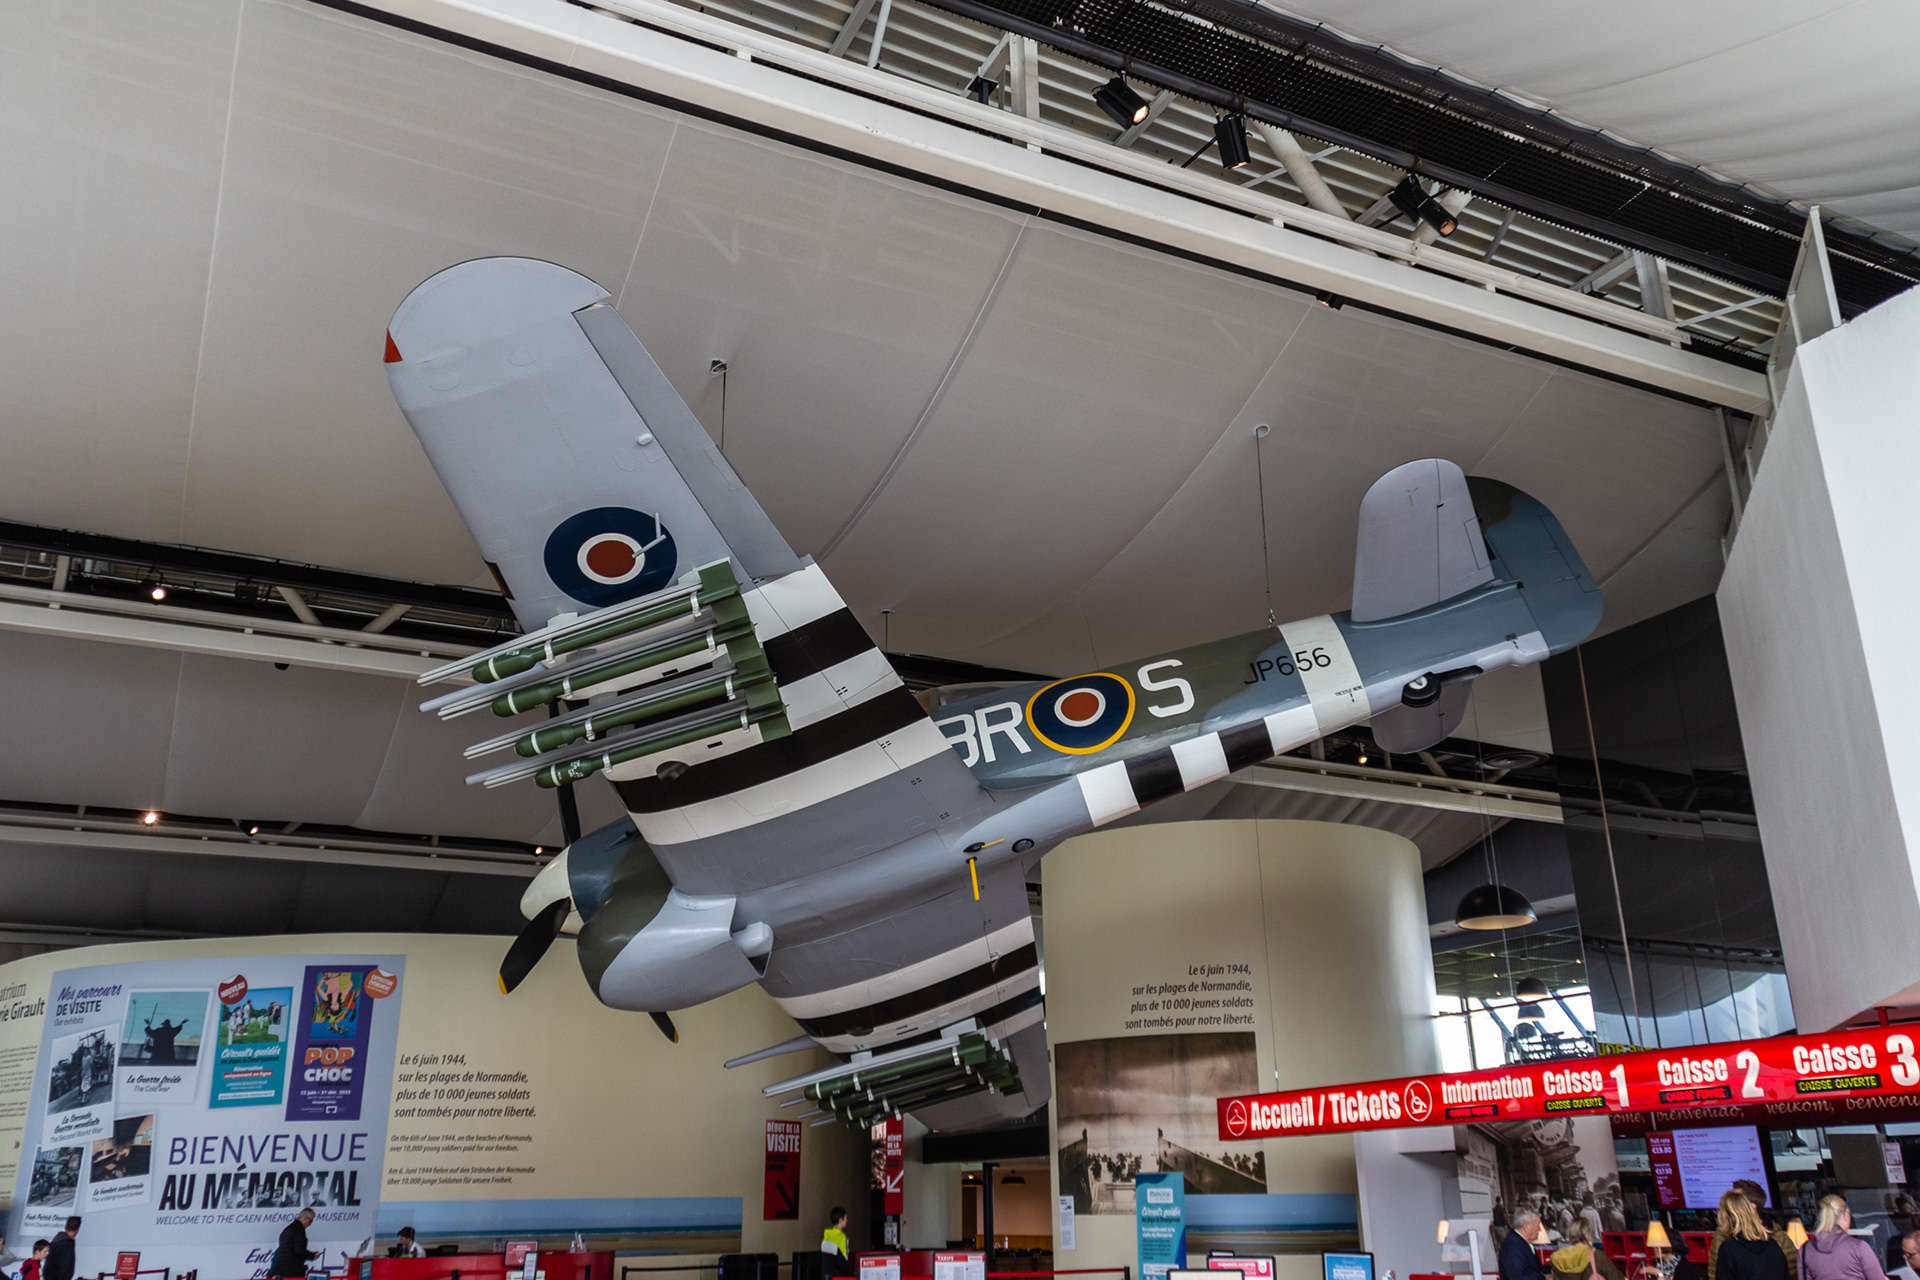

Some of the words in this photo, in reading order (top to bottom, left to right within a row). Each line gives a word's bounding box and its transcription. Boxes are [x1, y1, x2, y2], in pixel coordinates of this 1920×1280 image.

[1244, 647, 1331, 684] JP656
[1137, 659, 1196, 718] S
[1189, 965, 1198, 975] Le
[1200, 965, 1206, 975] 6
[1206, 964, 1224, 977] juin
[1227, 964, 1252, 975] 1944,
[57, 986, 76, 1002] Nos
[75, 984, 122, 1003] parcours
[1132, 986, 1145, 996] sur
[1146, 984, 1157, 995] les
[1158, 982, 1186, 996] plages
[1188, 982, 1199, 992] de
[1201, 980, 1252, 992] Normandie,
[11, 997, 45, 1020] Girault
[56, 1005, 68, 1016] DE
[69, 1000, 102, 1014] VISITE
[1131, 1001, 1148, 1014] plus
[1149, 1000, 1159, 1010] de
[1162, 1000, 1172, 1010] 10
[1173, 999, 1190, 1010] 000
[1190, 998, 1220, 1011] jeunes
[1222, 997, 1254, 1008] soldats
[1125, 1019, 1142, 1029] sont
[1144, 1016, 1174, 1028] tombés
[1175, 1017, 1196, 1029] pour
[1198, 1015, 1222, 1025] notre
[1223, 1014, 1255, 1024] liberté.
[221, 1047, 252, 1058] Circuits
[254, 1045, 281, 1058] guidés
[304, 1047, 354, 1065] POP
[400, 1054, 410, 1065] Le
[412, 1054, 418, 1065] 6
[418, 1054, 438, 1067] juin
[441, 1054, 467, 1067] 1944,
[1793, 1043, 1878, 1075] Caisse
[1885, 1034, 1920, 1087] 3
[127, 1075, 135, 1083] La
[137, 1075, 160, 1083] Guerre
[304, 1068, 352, 1082] CHOC
[398, 1074, 414, 1083] sur
[415, 1072, 427, 1082] les
[429, 1072, 460, 1085] plages
[462, 1071, 473, 1082] de
[475, 1071, 528, 1084] Normandie,
[1657, 1057, 1728, 1086] Caisse
[1736, 1050, 1765, 1099] 2
[1441, 1075, 1534, 1105] Information
[1542, 1069, 1603, 1096] Caisse
[1610, 1064, 1630, 1108] 1
[1798, 1080, 1833, 1092] CAISSE
[1835, 1075, 1878, 1088] OUVERTE
[396, 1089, 417, 1102] plus
[419, 1089, 431, 1100] de
[433, 1089, 445, 1099] 10
[446, 1089, 465, 1100] 000
[464, 1089, 496, 1102] jeunes
[498, 1089, 530, 1100] soldats
[1251, 1096, 1315, 1131] Accueil
[1318, 1094, 1325, 1126] /
[1328, 1090, 1401, 1124] Tickets
[1546, 1099, 1572, 1111] CAISSE
[1572, 1097, 1603, 1109] OUVERTE
[62, 1116, 69, 1124] La
[70, 1112, 92, 1122] Seconde
[394, 1108, 415, 1118] sont
[417, 1106, 452, 1117] tombés
[453, 1109, 475, 1120] pour
[478, 1108, 502, 1117] notre
[504, 1106, 536, 1117] liberté.
[54, 1125, 72, 1134] Guerre
[73, 1118, 100, 1130] mondiale
[767, 1121, 785, 1133] DÉBUT
[786, 1124, 794, 1133] DE
[794, 1124, 799, 1134] LA
[59, 1133, 75, 1142] Second
[76, 1130, 91, 1138] World
[92, 1128, 103, 1136] War
[420, 1135, 427, 1143] of
[427, 1135, 440, 1143] June
[498, 1135, 504, 1143] of
[504, 1135, 533, 1143] Normandy,
[887, 1134, 902, 1142] DÉBUT
[168, 1132, 368, 1165] BIENVENUE
[403, 1145, 423, 1153] 10,000
[462, 1145, 476, 1153] paid
[476, 1145, 485, 1153] for
[767, 1134, 800, 1153] VISITE
[405, 1167, 417, 1175] Juni
[158, 1174, 196, 1211] AU
[200, 1162, 361, 1210] MÉMORIAL
[387, 1177, 400, 1185] über
[421, 1178, 437, 1186] junge
[156, 1215, 199, 1225] WELCOME
[202, 1215, 214, 1224] TO
[216, 1214, 233, 1224] THE
[236, 1214, 263, 1223] CAEN
[316, 1212, 360, 1222] MUSEUM
